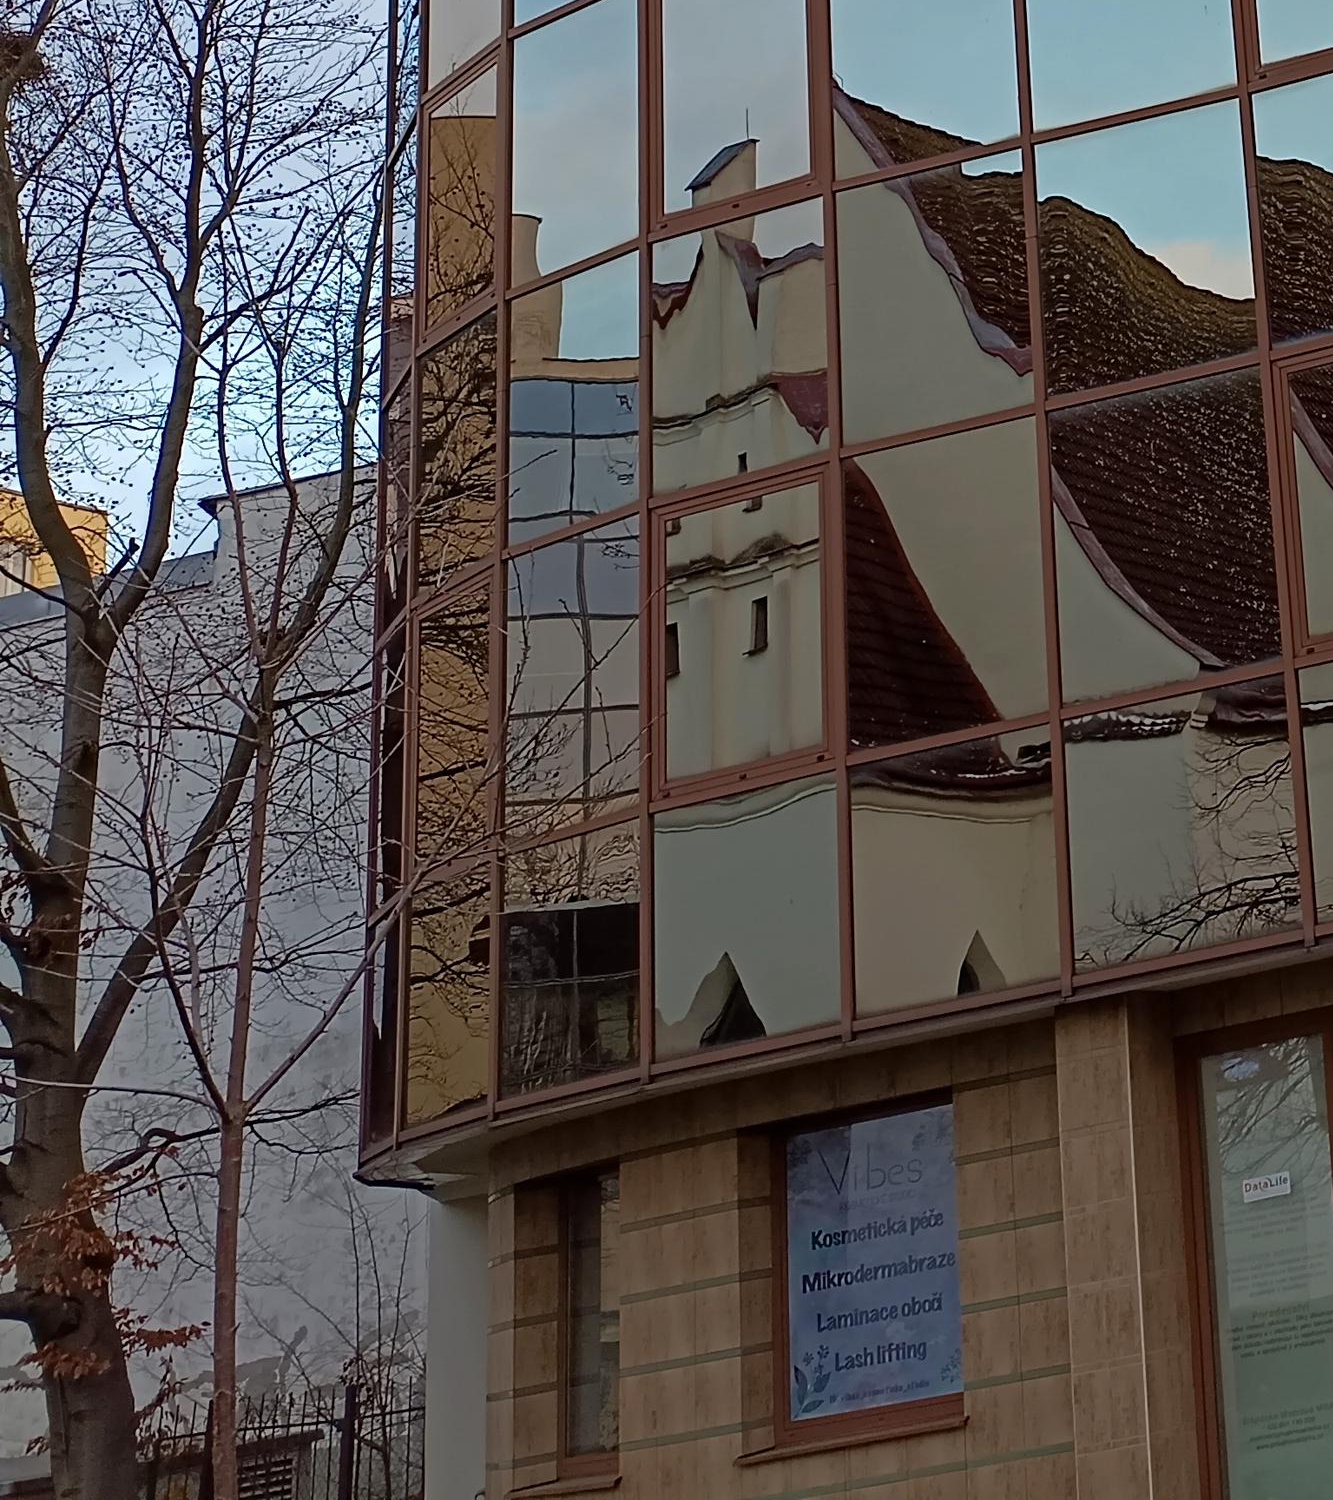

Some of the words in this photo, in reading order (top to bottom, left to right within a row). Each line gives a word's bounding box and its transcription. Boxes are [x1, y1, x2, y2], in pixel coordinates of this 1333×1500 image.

[817, 1141, 924, 1195] Vibes
[811, 1214, 907, 1251] Kosmetická
[910, 1206, 945, 1237] péče
[801, 1250, 957, 1295] Mikrodermabraze
[816, 1303, 898, 1333] Laminace
[902, 1291, 944, 1317] obočí
[834, 1345, 875, 1372] Lash
[876, 1340, 928, 1366] lifting
